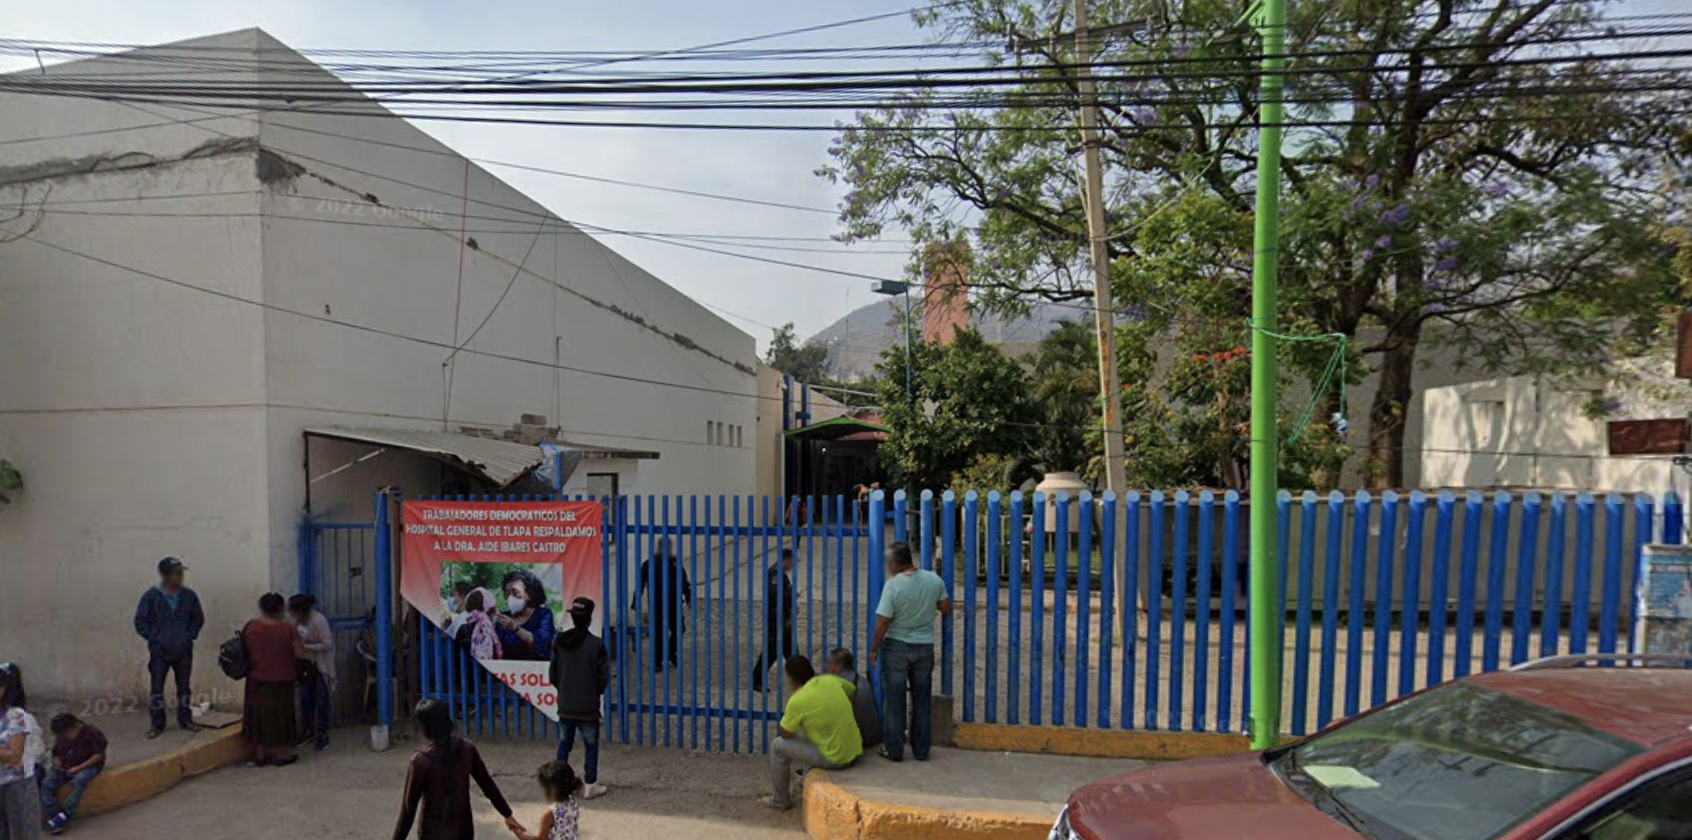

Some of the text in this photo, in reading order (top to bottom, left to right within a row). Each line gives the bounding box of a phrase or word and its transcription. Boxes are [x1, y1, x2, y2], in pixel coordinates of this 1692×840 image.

[423, 509, 577, 521] TRABAJADORES DEMOCRATICOS DEL
[406, 524, 597, 537] HOSPITAL GENERAL DE TLAPA RESPALDAMOS
[434, 541, 566, 553] A LA DRA. AIDE IBARES CASTRO
[520, 673, 552, 687] SOL
[536, 692, 557, 706] SO
